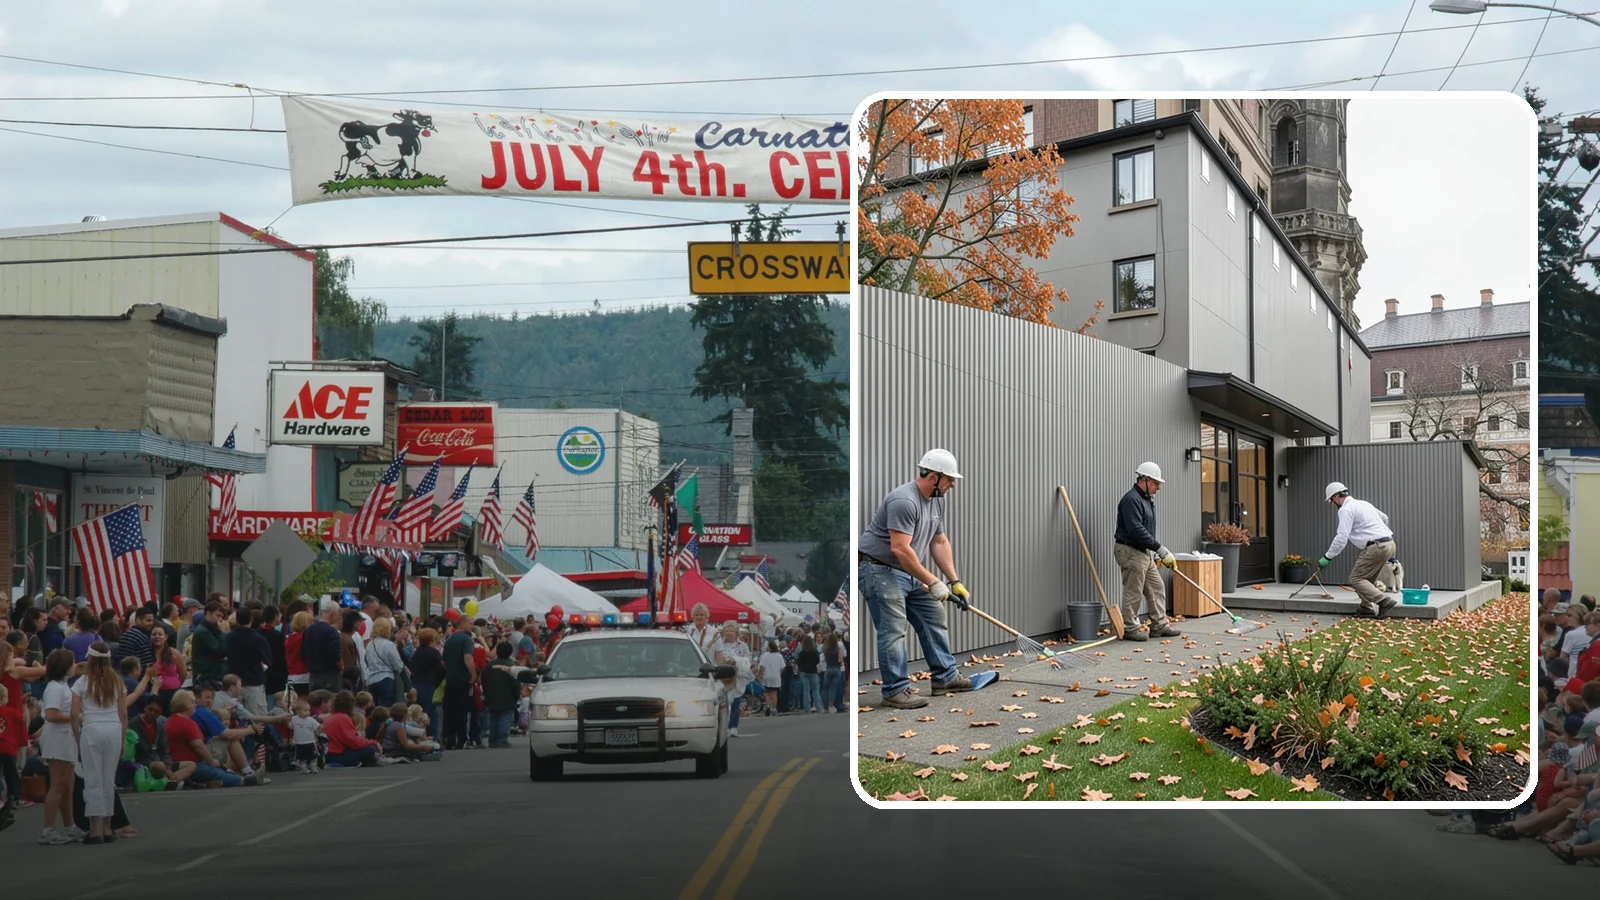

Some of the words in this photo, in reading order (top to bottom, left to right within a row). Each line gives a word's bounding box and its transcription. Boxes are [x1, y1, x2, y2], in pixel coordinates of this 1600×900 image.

[695, 122, 850, 149] Carnat
[481, 141, 604, 192] JULY
[632, 150, 746, 197] 4th.
[697, 255, 850, 280] CROSSWA
[283, 380, 373, 419] ACE
[406, 409, 452, 422] CEDAR
[461, 409, 485, 421] LOG
[284, 421, 370, 436] Hardware
[416, 428, 476, 447] Coca-Cola
[354, 467, 385, 480] Simpl
[95, 485, 124, 494] Vincent
[126, 486, 135, 494] de
[137, 486, 155, 495] Paul
[688, 526, 741, 535] CRNATION
[699, 535, 730, 543] GLASS
